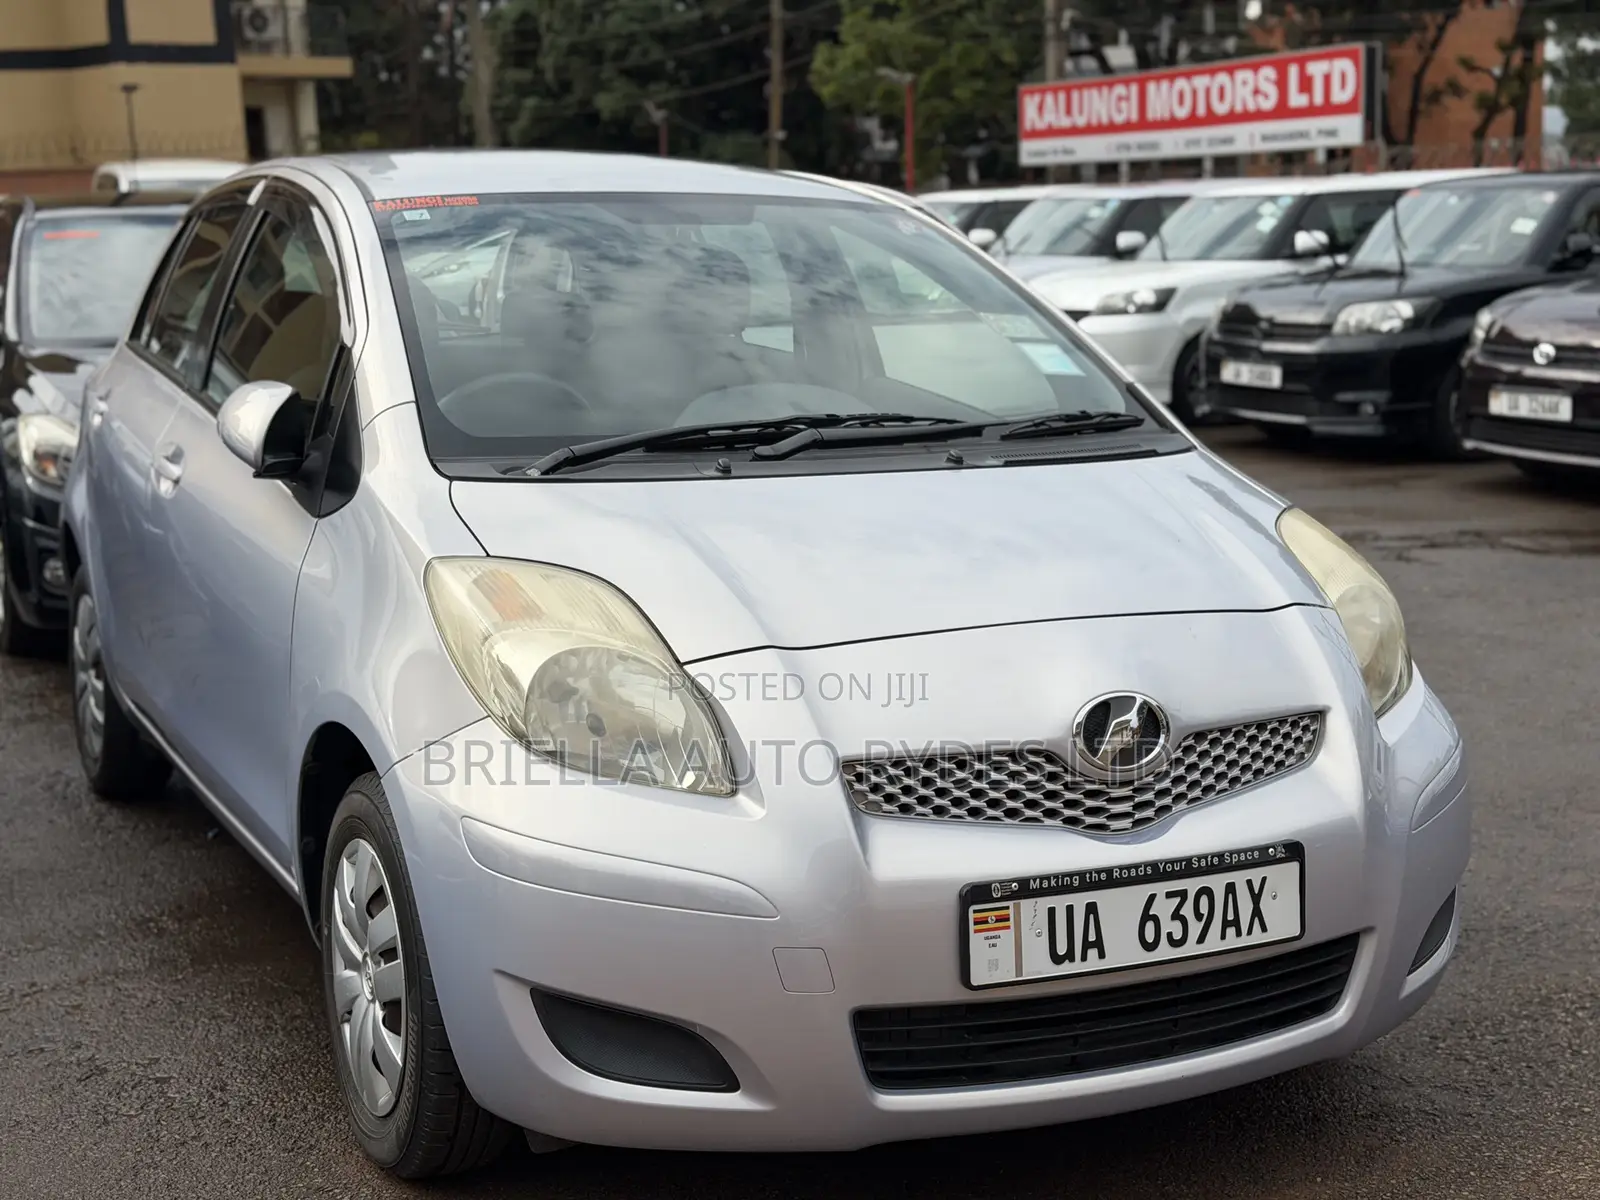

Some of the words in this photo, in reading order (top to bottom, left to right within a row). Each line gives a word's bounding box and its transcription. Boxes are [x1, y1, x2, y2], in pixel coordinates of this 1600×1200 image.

[1023, 83, 1139, 131] KALUNGI
[1146, 65, 1279, 122] MOTORS
[1287, 57, 1357, 109] LTD
[1029, 875, 1080, 889] Making
[1085, 870, 1107, 882] the
[1113, 865, 1153, 879] Roads
[1158, 859, 1188, 873] Your
[1192, 855, 1219, 868] Safe
[1224, 849, 1260, 864] Space
[1047, 901, 1106, 965] UA
[1138, 875, 1268, 953] 639AX
